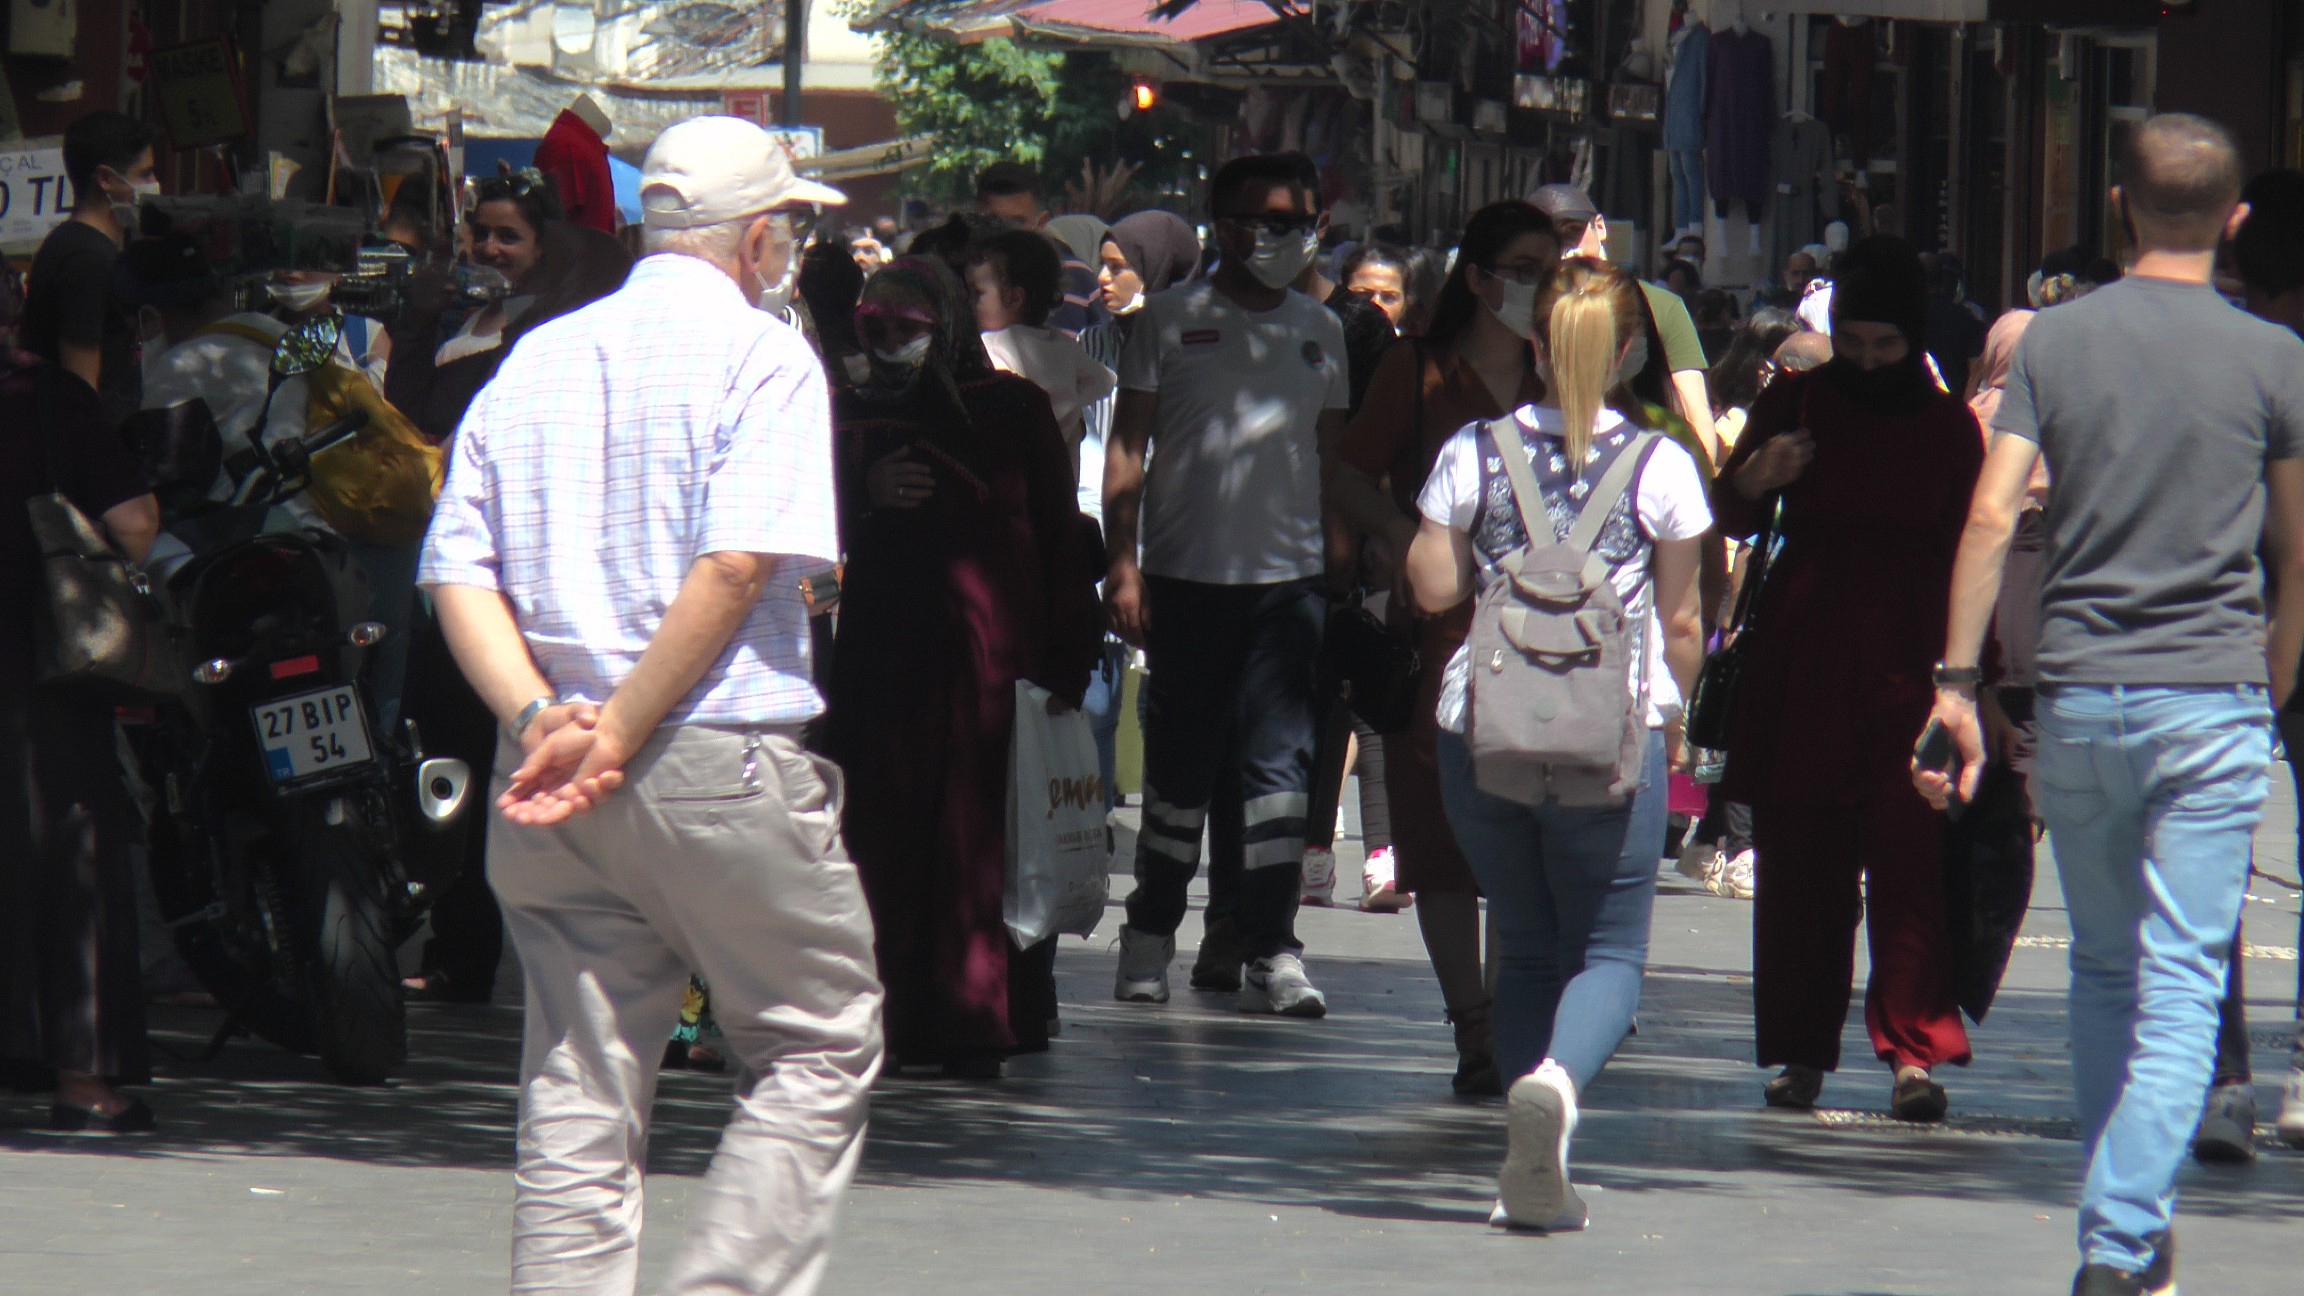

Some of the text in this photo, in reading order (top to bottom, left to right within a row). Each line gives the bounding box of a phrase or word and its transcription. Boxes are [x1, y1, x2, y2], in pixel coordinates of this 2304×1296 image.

[27, 175, 76, 215] TL
[263, 694, 351, 739] 27 BIP
[311, 733, 346, 763] 54
